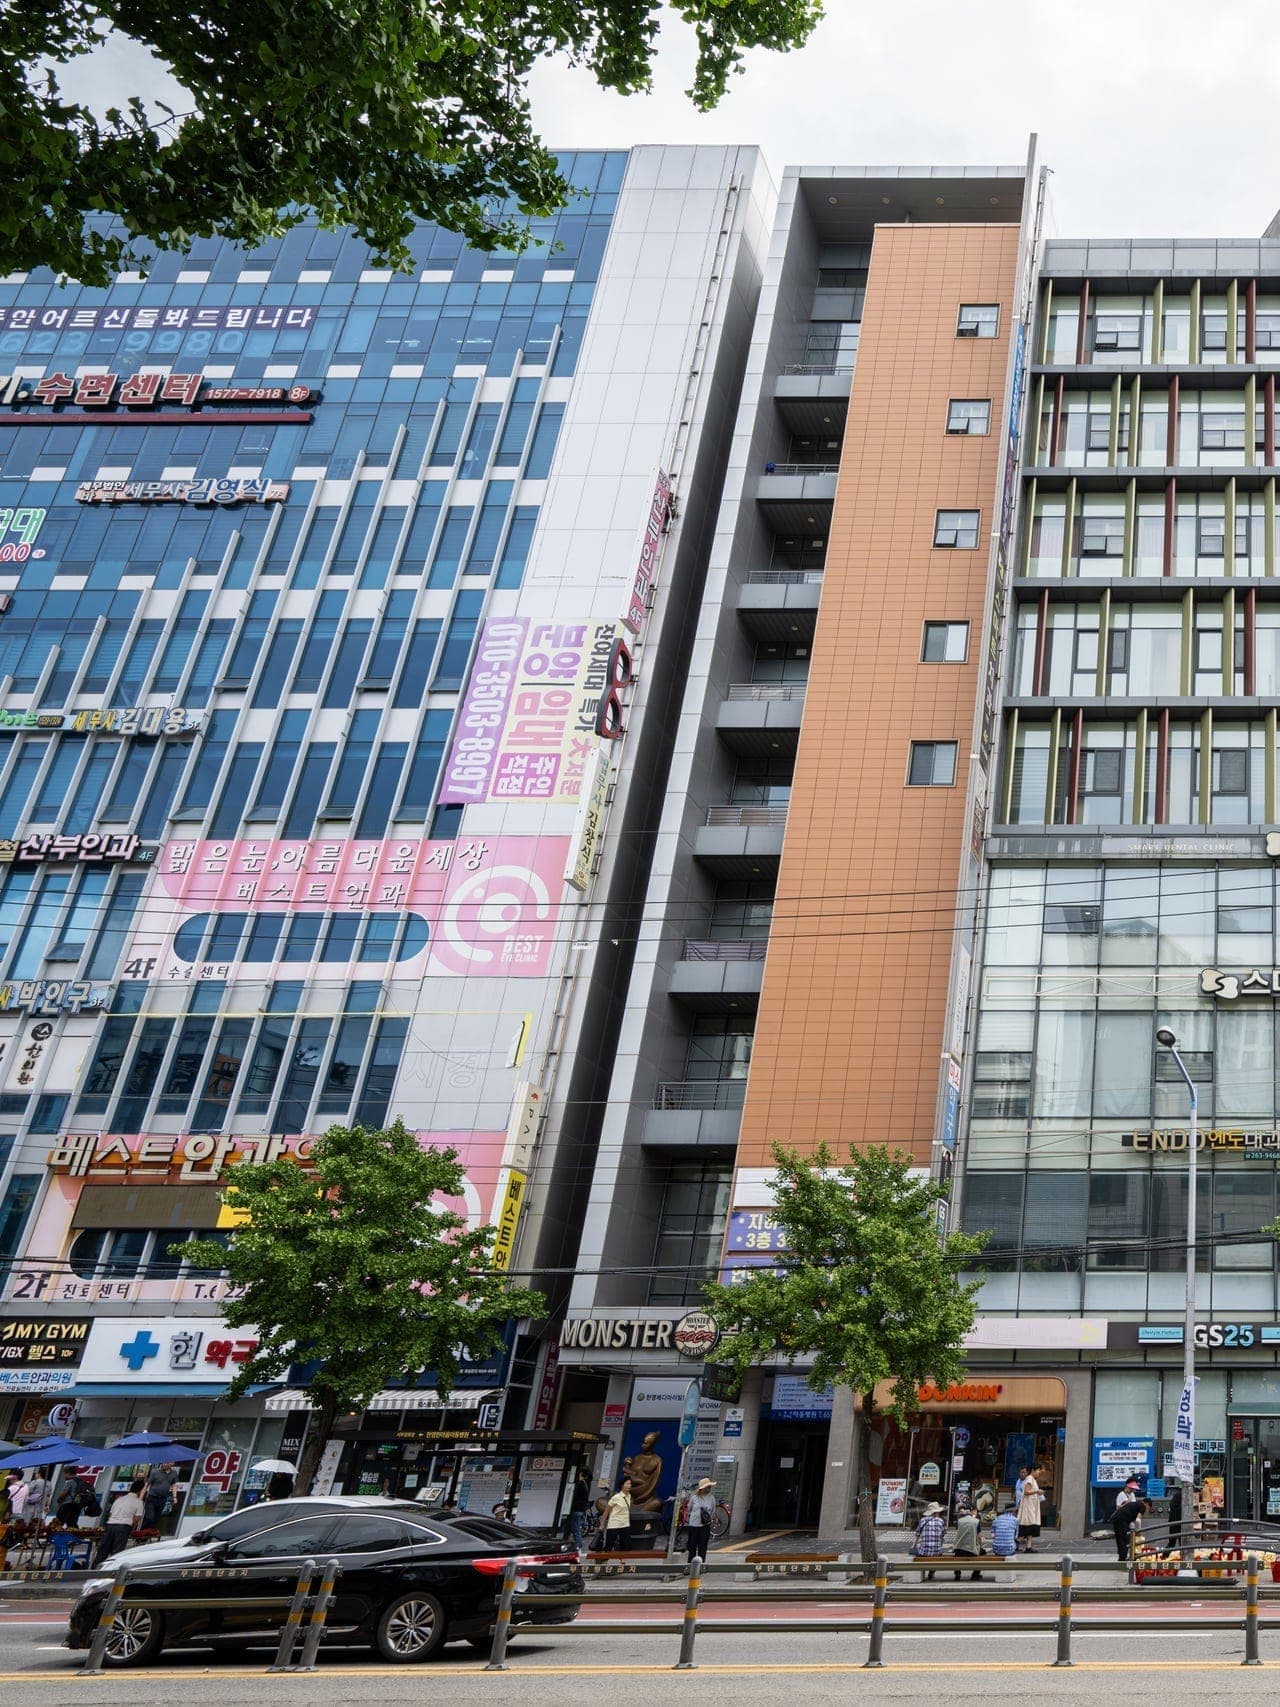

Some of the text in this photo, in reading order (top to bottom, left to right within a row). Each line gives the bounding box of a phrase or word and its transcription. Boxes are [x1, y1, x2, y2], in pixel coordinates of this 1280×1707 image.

[33, 373, 205, 405] 수면센터
[207, 388, 282, 400] 1577-7918
[185, 478, 274, 503] 김영식
[507, 623, 590, 748] 분양 임대
[119, 706, 188, 736] 김대용
[19, 833, 142, 861] 산부인과
[504, 934, 545, 953] BEST
[18, 981, 92, 1015] 박인구
[1132, 1128, 1206, 1151] ENDO
[15, 1324, 88, 1339] MY GYM
[558, 1319, 673, 1348] MONSTER
[1193, 1324, 1255, 1348] GS25
[27, 1345, 57, 1360] 헬스
[201, 1450, 242, 1492] 약
